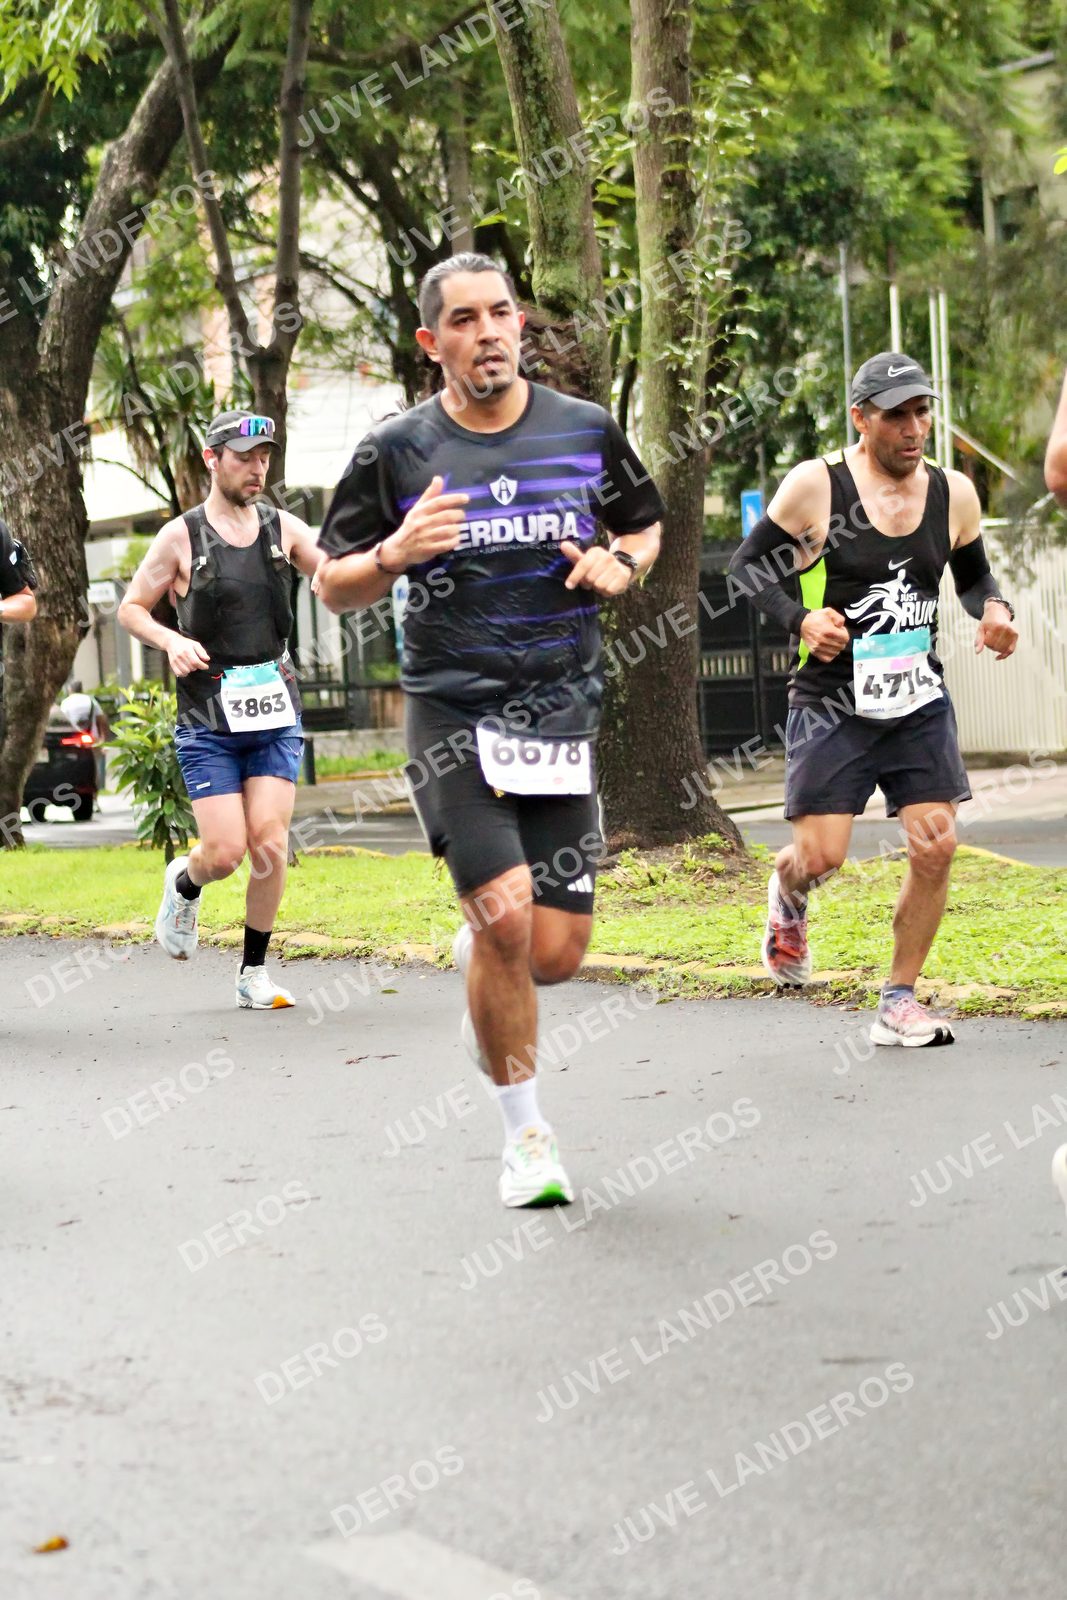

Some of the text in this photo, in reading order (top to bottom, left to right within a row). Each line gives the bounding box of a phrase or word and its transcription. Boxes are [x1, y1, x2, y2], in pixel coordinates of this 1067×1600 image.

[454, 512, 579, 550] ERDURA
[900, 593, 917, 602] JUST
[901, 600, 936, 626] RUN
[228, 693, 287, 718] 3863
[491, 738, 581, 766] 6678
